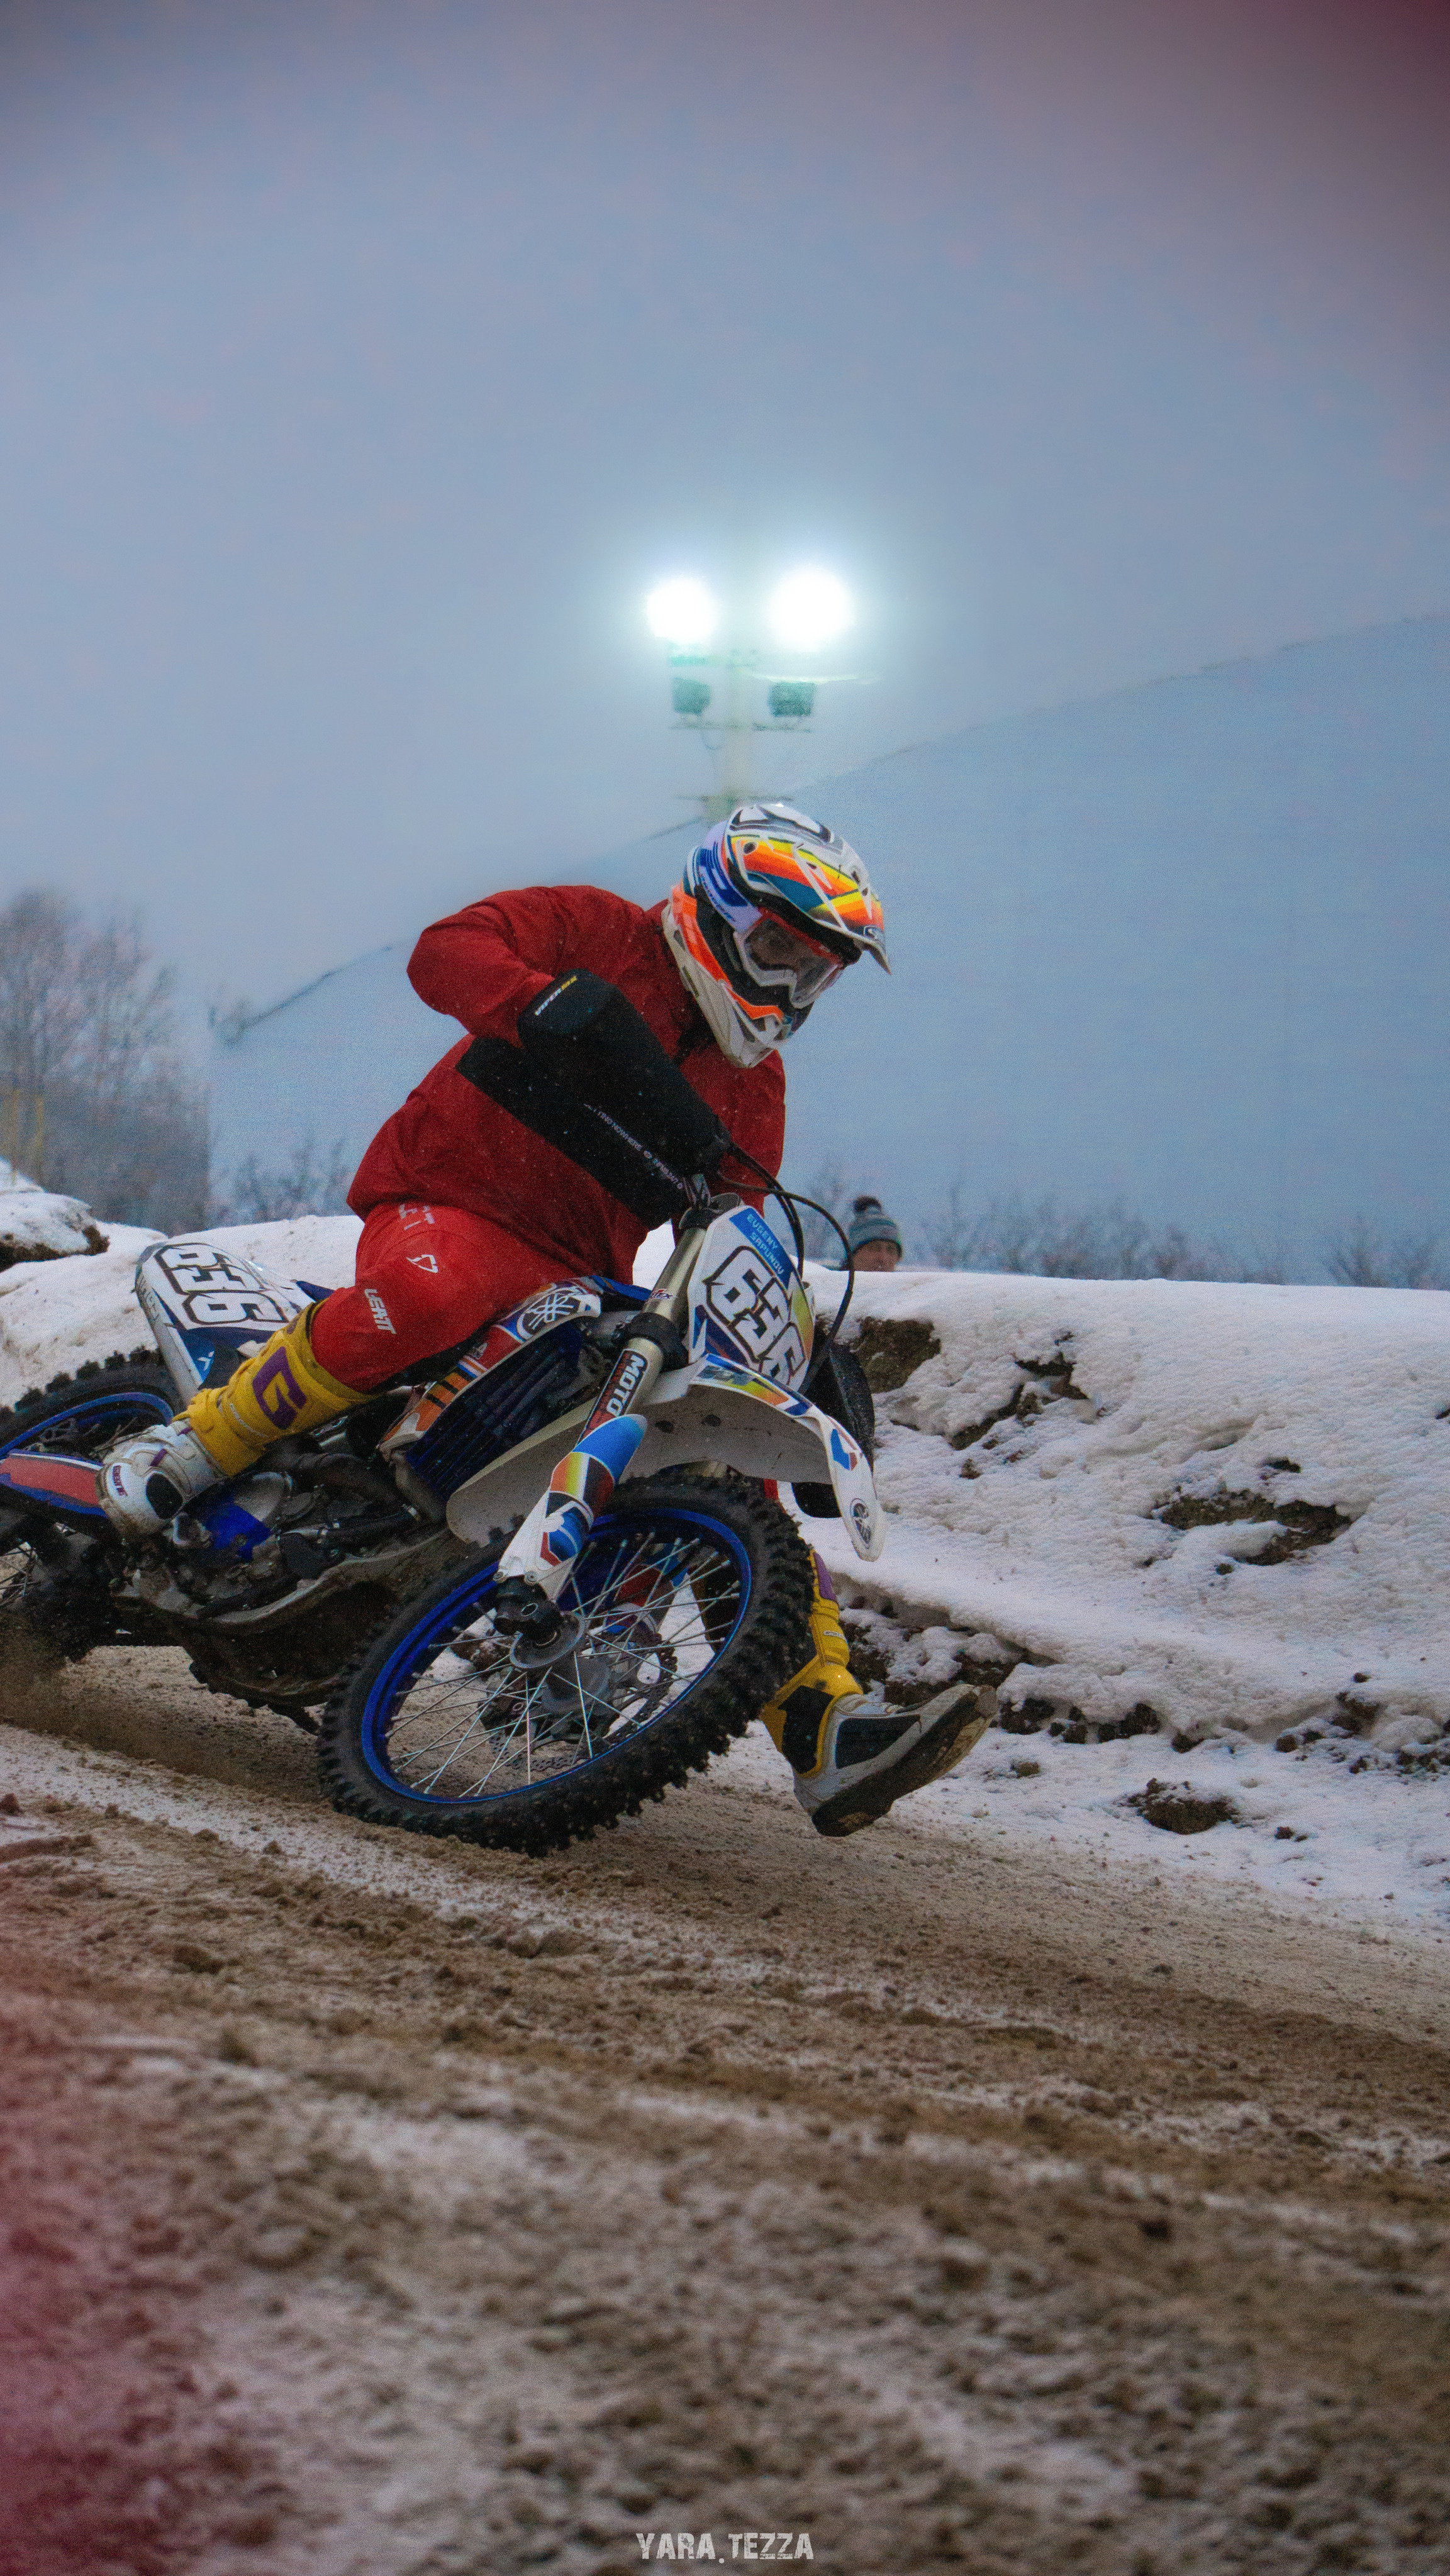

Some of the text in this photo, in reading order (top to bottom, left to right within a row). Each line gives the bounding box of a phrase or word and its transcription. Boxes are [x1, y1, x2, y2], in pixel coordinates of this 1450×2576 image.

[747, 1214, 778, 1250] EVGENY
[750, 1232, 784, 1274] SAPUNOV
[153, 1243, 289, 1325] 636
[364, 1289, 397, 1334] LEATT
[606, 1354, 645, 1416] MOTO
